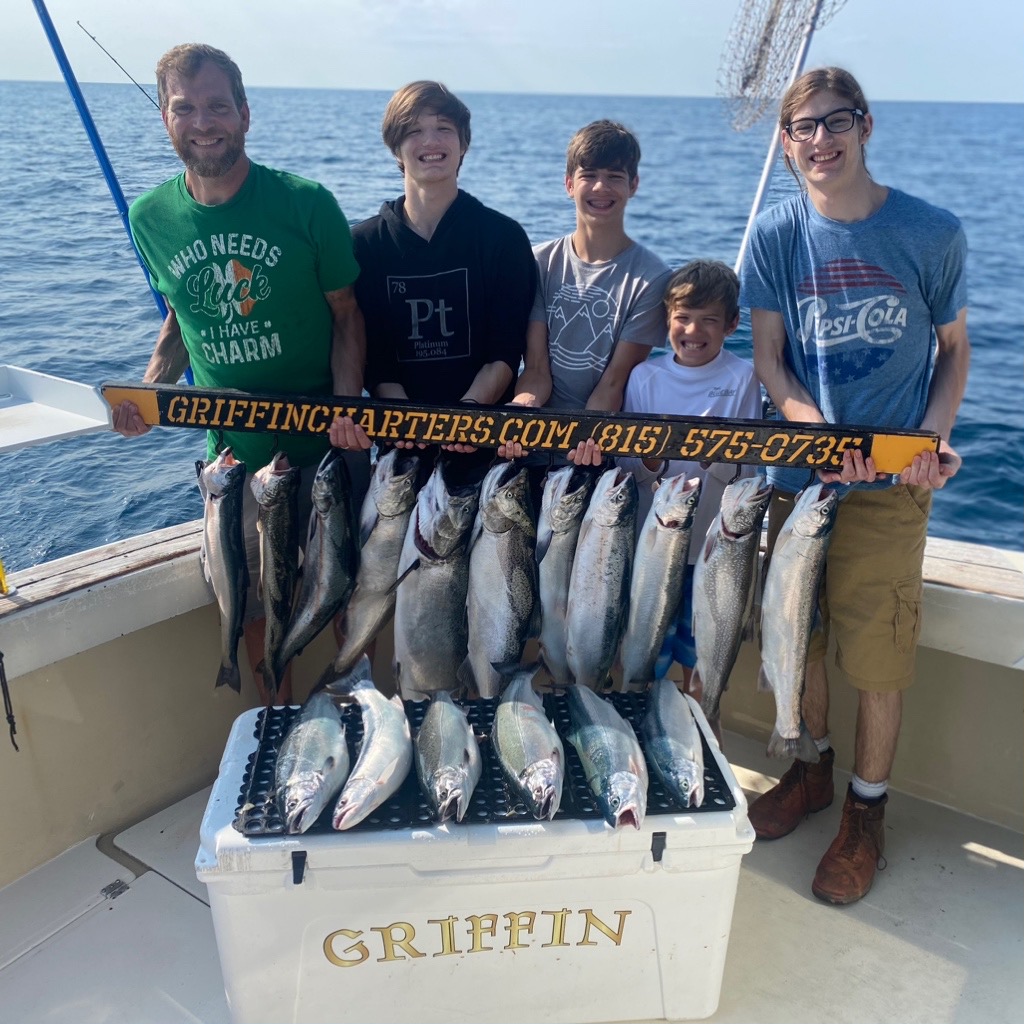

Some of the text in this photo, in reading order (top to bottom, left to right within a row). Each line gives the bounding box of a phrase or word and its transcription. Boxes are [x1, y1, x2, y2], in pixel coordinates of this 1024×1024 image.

[167, 233, 283, 280] WHO NEEDS
[186, 264, 272, 318] Luck
[391, 281, 407, 294] 78
[210, 320, 260, 340] I HAVE
[405, 299, 455, 340] Pt
[201, 332, 283, 365] CHARM
[413, 340, 449, 350] Platinum
[591, 421, 672, 457] (815)
[680, 429, 864, 466] 575-0735
[322, 907, 632, 968] GRIFFIN
